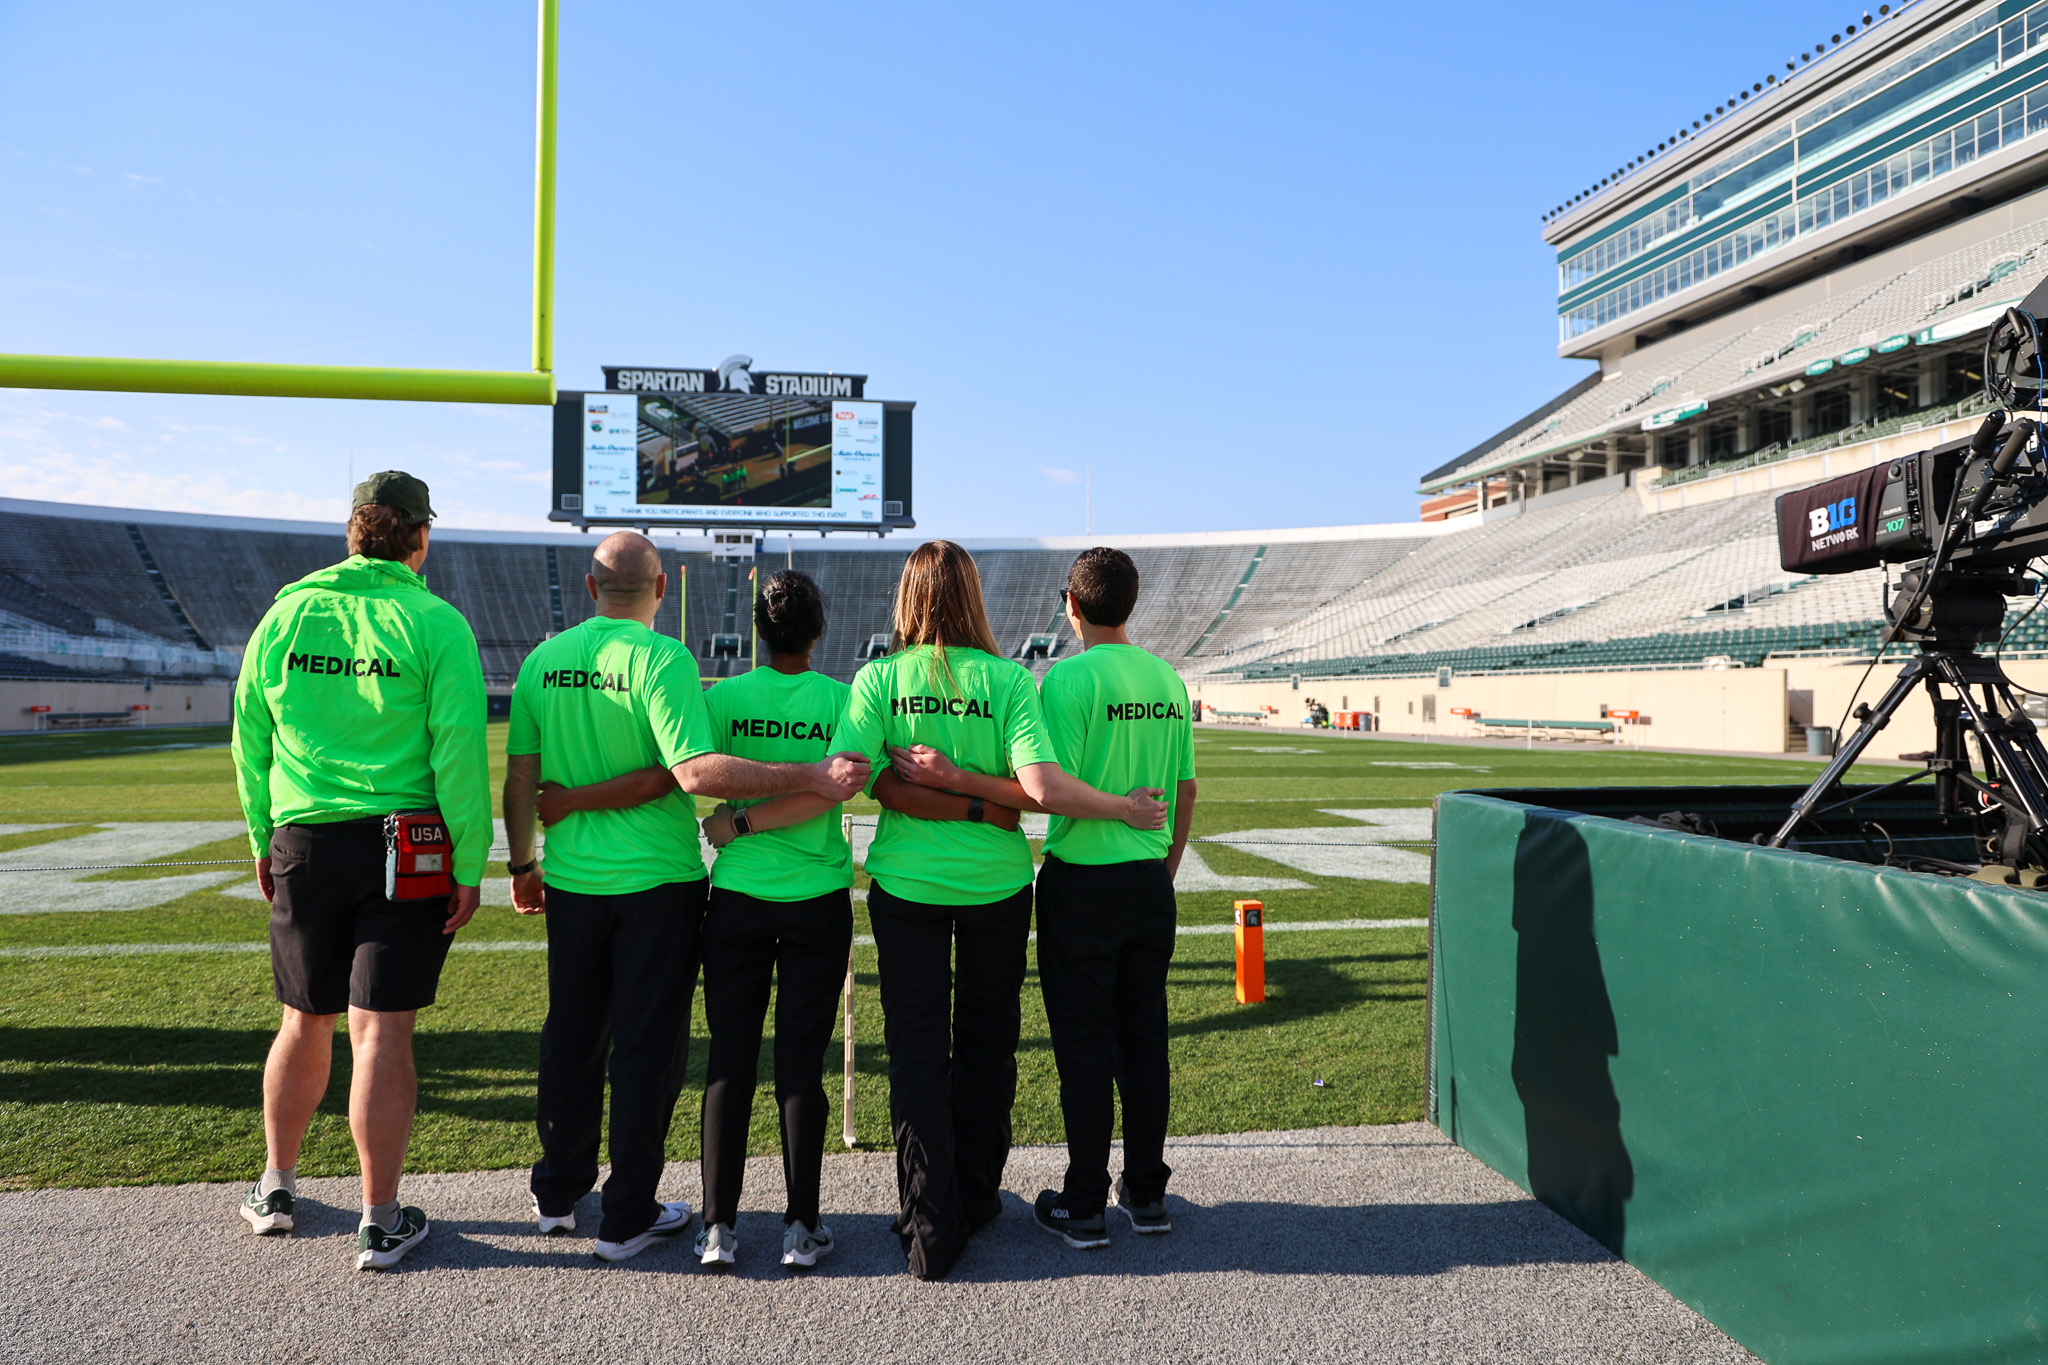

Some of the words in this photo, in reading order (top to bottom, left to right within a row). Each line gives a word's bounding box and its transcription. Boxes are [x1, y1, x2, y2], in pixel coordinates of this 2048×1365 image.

[617, 370, 705, 392] SPARTAN
[765, 375, 852, 397] STADIUM
[620, 507, 642, 515] THANK
[706, 508, 719, 516] AND
[774, 510, 809, 518] SUPPORTED
[1885, 518, 1905, 532] 107
[1811, 527, 1859, 551] NETWORK
[288, 652, 400, 677] MEDICAL
[543, 670, 629, 692] MEDCAL
[891, 696, 993, 718] MEDICAL
[1107, 702, 1184, 721] MEDICAL
[732, 719, 833, 742] MEDICAL
[411, 827, 443, 841] USA
[1050, 1208, 1070, 1219] HOKA
